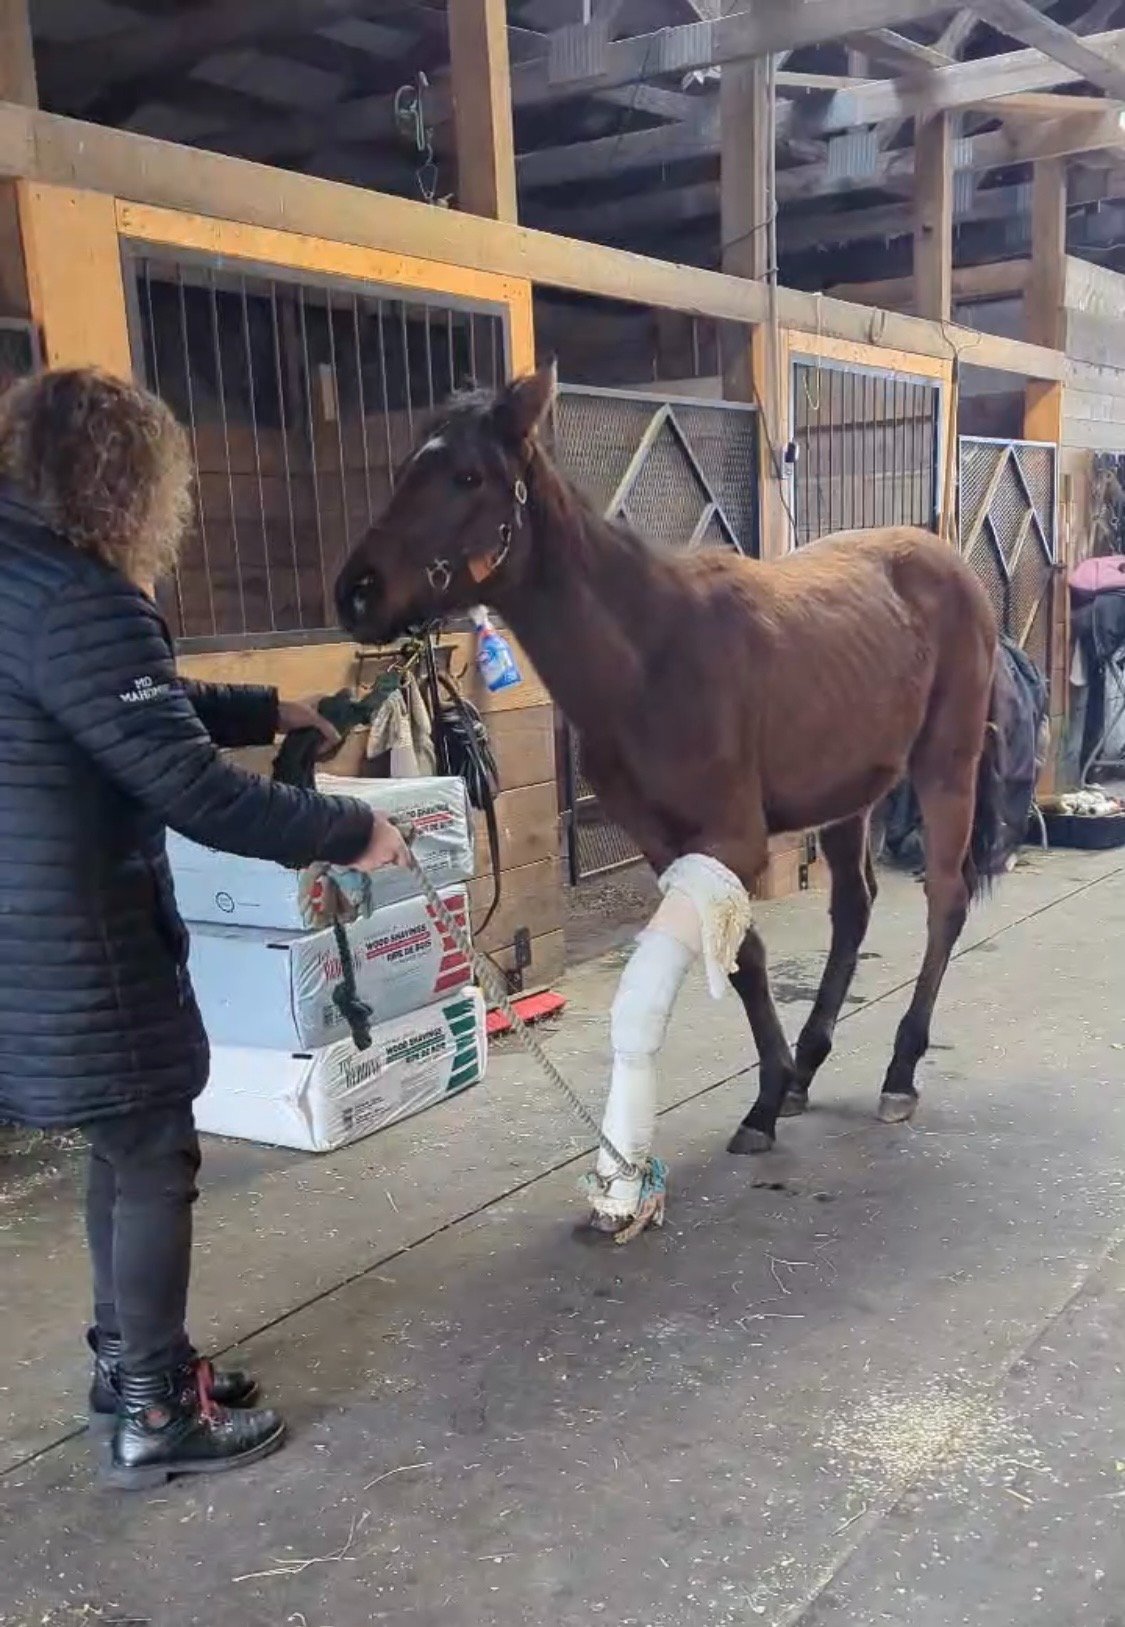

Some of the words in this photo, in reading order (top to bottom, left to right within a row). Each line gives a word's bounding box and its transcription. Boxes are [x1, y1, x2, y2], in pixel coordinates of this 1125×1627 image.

[134, 676, 152, 689] MD
[365, 936, 390, 951] WOOD
[391, 924, 427, 942] SHAVINGS
[386, 1040, 409, 1055] WOOD
[409, 1027, 443, 1046] SHAVINGS
